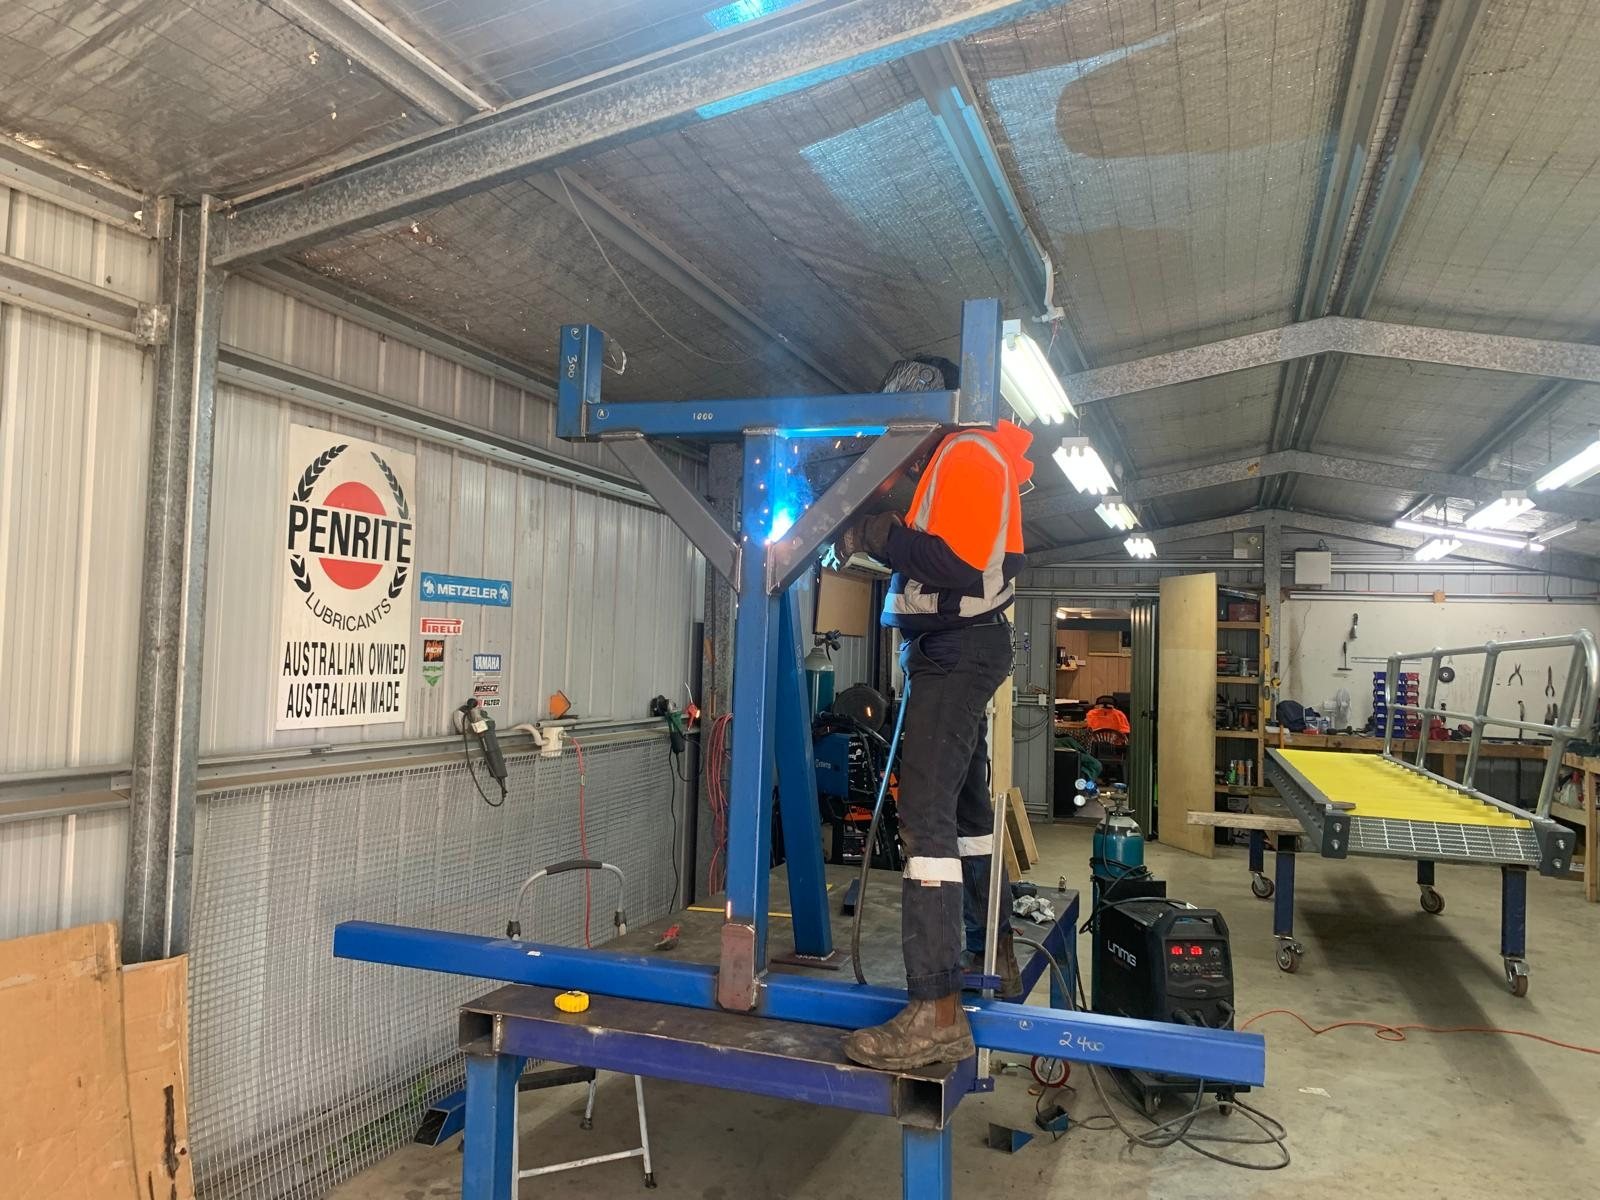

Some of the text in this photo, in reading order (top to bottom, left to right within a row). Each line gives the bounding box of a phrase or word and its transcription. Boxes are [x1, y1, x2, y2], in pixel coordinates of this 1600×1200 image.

[567, 354, 578, 378] 300
[693, 412, 713, 421] 1000
[287, 504, 412, 564] PENRITE
[437, 583, 498, 599] METZELER
[305, 592, 392, 632] LUBRICANTS
[421, 619, 462, 633] PIRELLI
[283, 641, 406, 676] AUSTRALIAN OWNED
[474, 655, 500, 670] YAMAHA
[286, 681, 400, 718] AUSTRALIAN MADE
